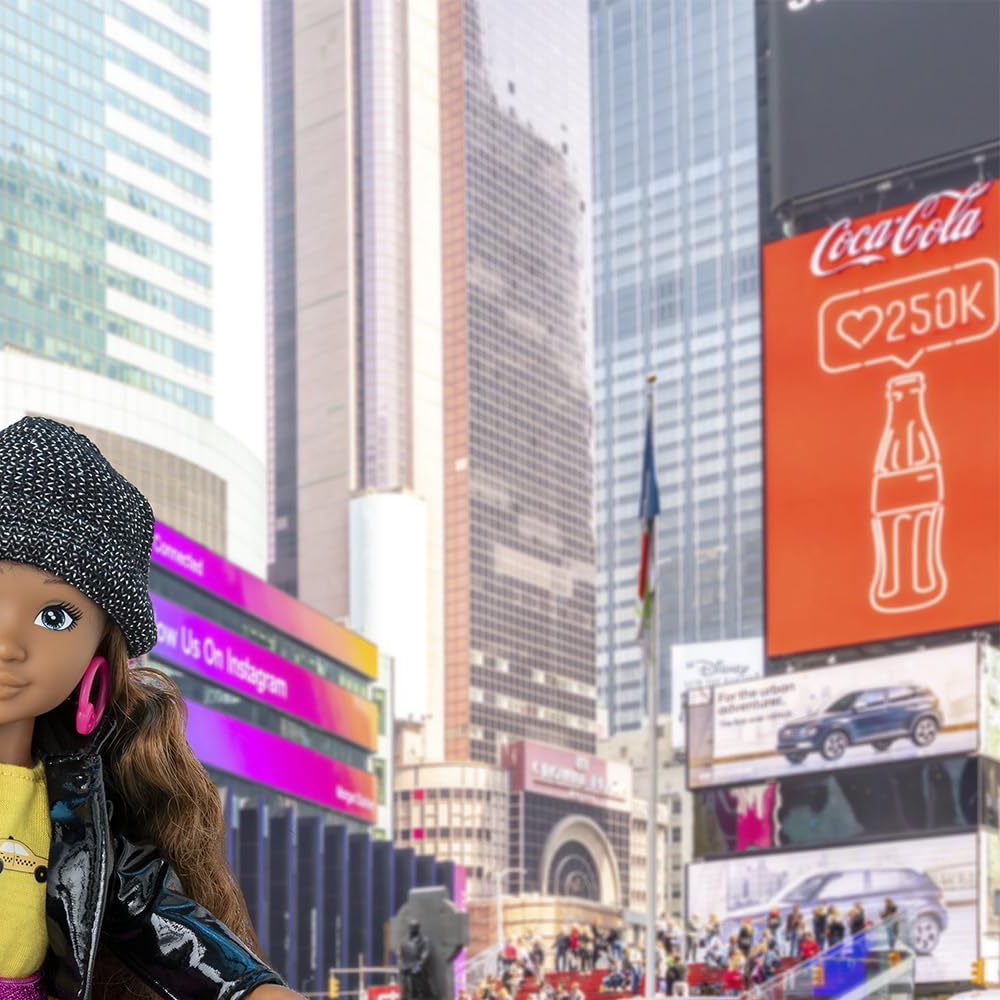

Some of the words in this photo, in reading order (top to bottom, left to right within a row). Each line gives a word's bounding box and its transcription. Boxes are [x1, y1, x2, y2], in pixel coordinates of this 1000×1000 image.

[810, 180, 990, 278] Coca-Cola
[886, 280, 986, 342] 250K
[181, 626, 201, 660] Us
[203, 637, 225, 671] On
[226, 646, 289, 700] Instagram
